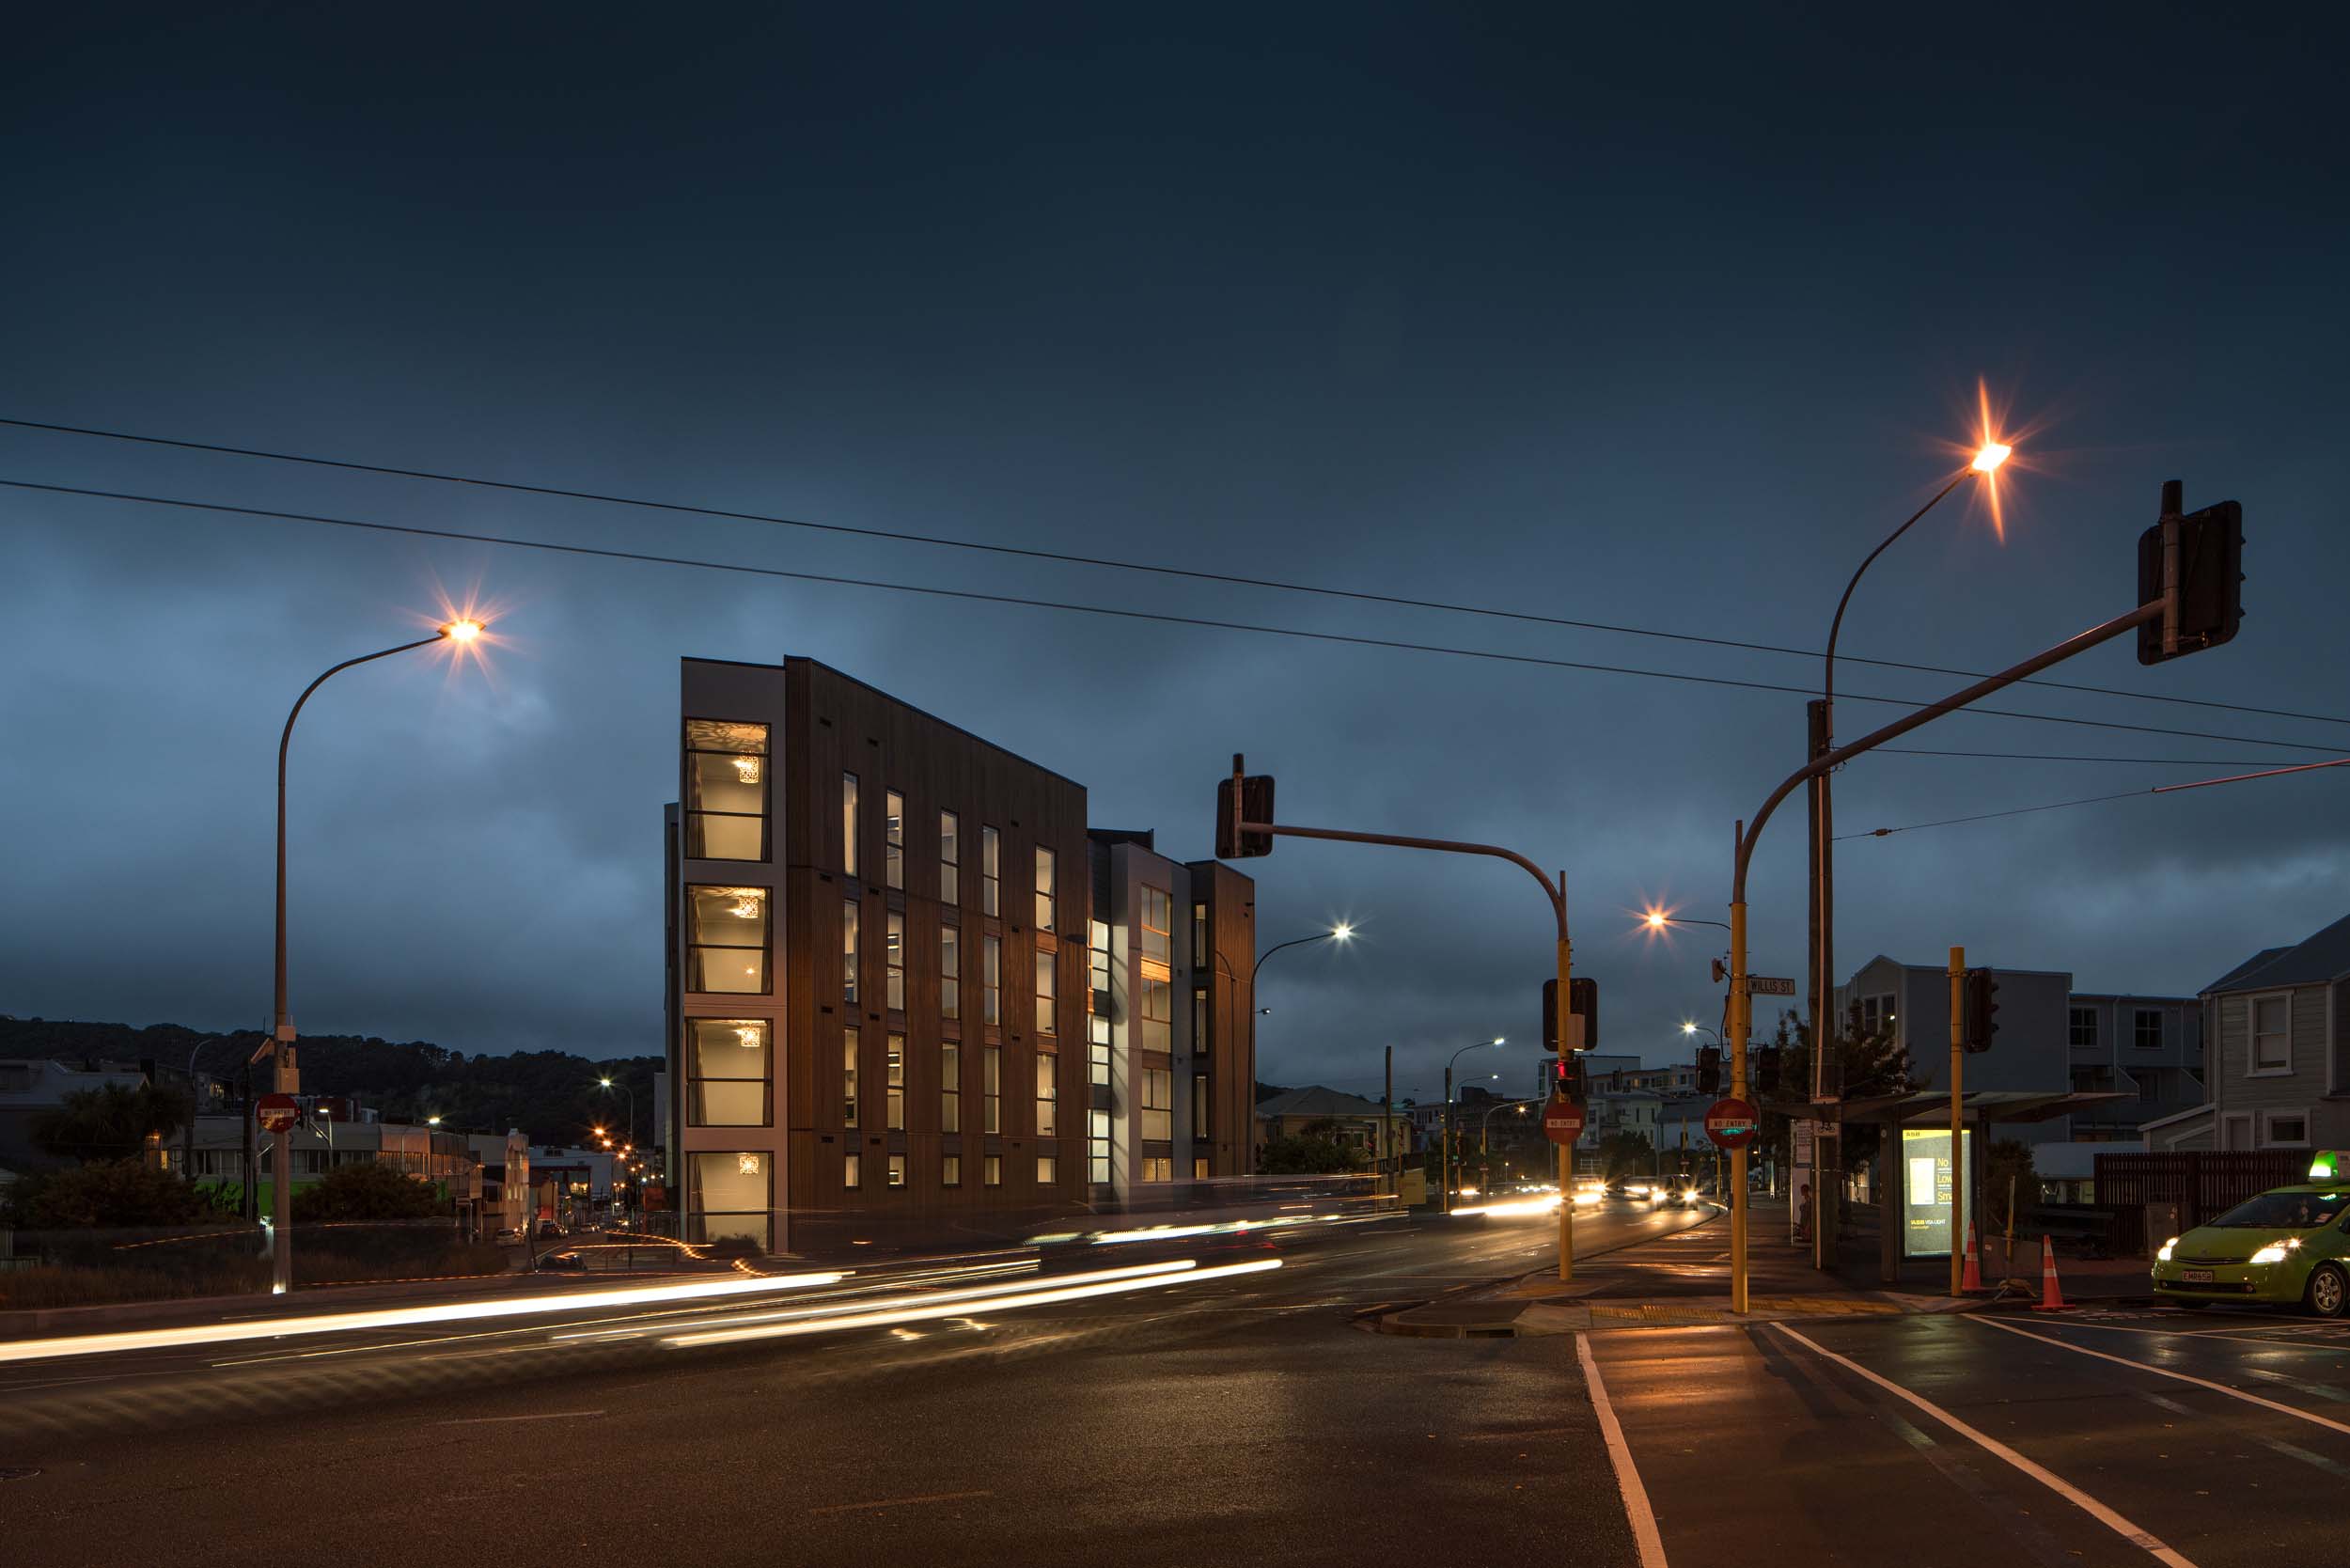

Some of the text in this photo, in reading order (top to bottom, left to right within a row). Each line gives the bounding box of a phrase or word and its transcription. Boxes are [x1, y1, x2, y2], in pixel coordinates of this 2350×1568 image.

[1750, 980, 1790, 992] WILLIS ST
[1937, 1158, 1949, 1167] No
